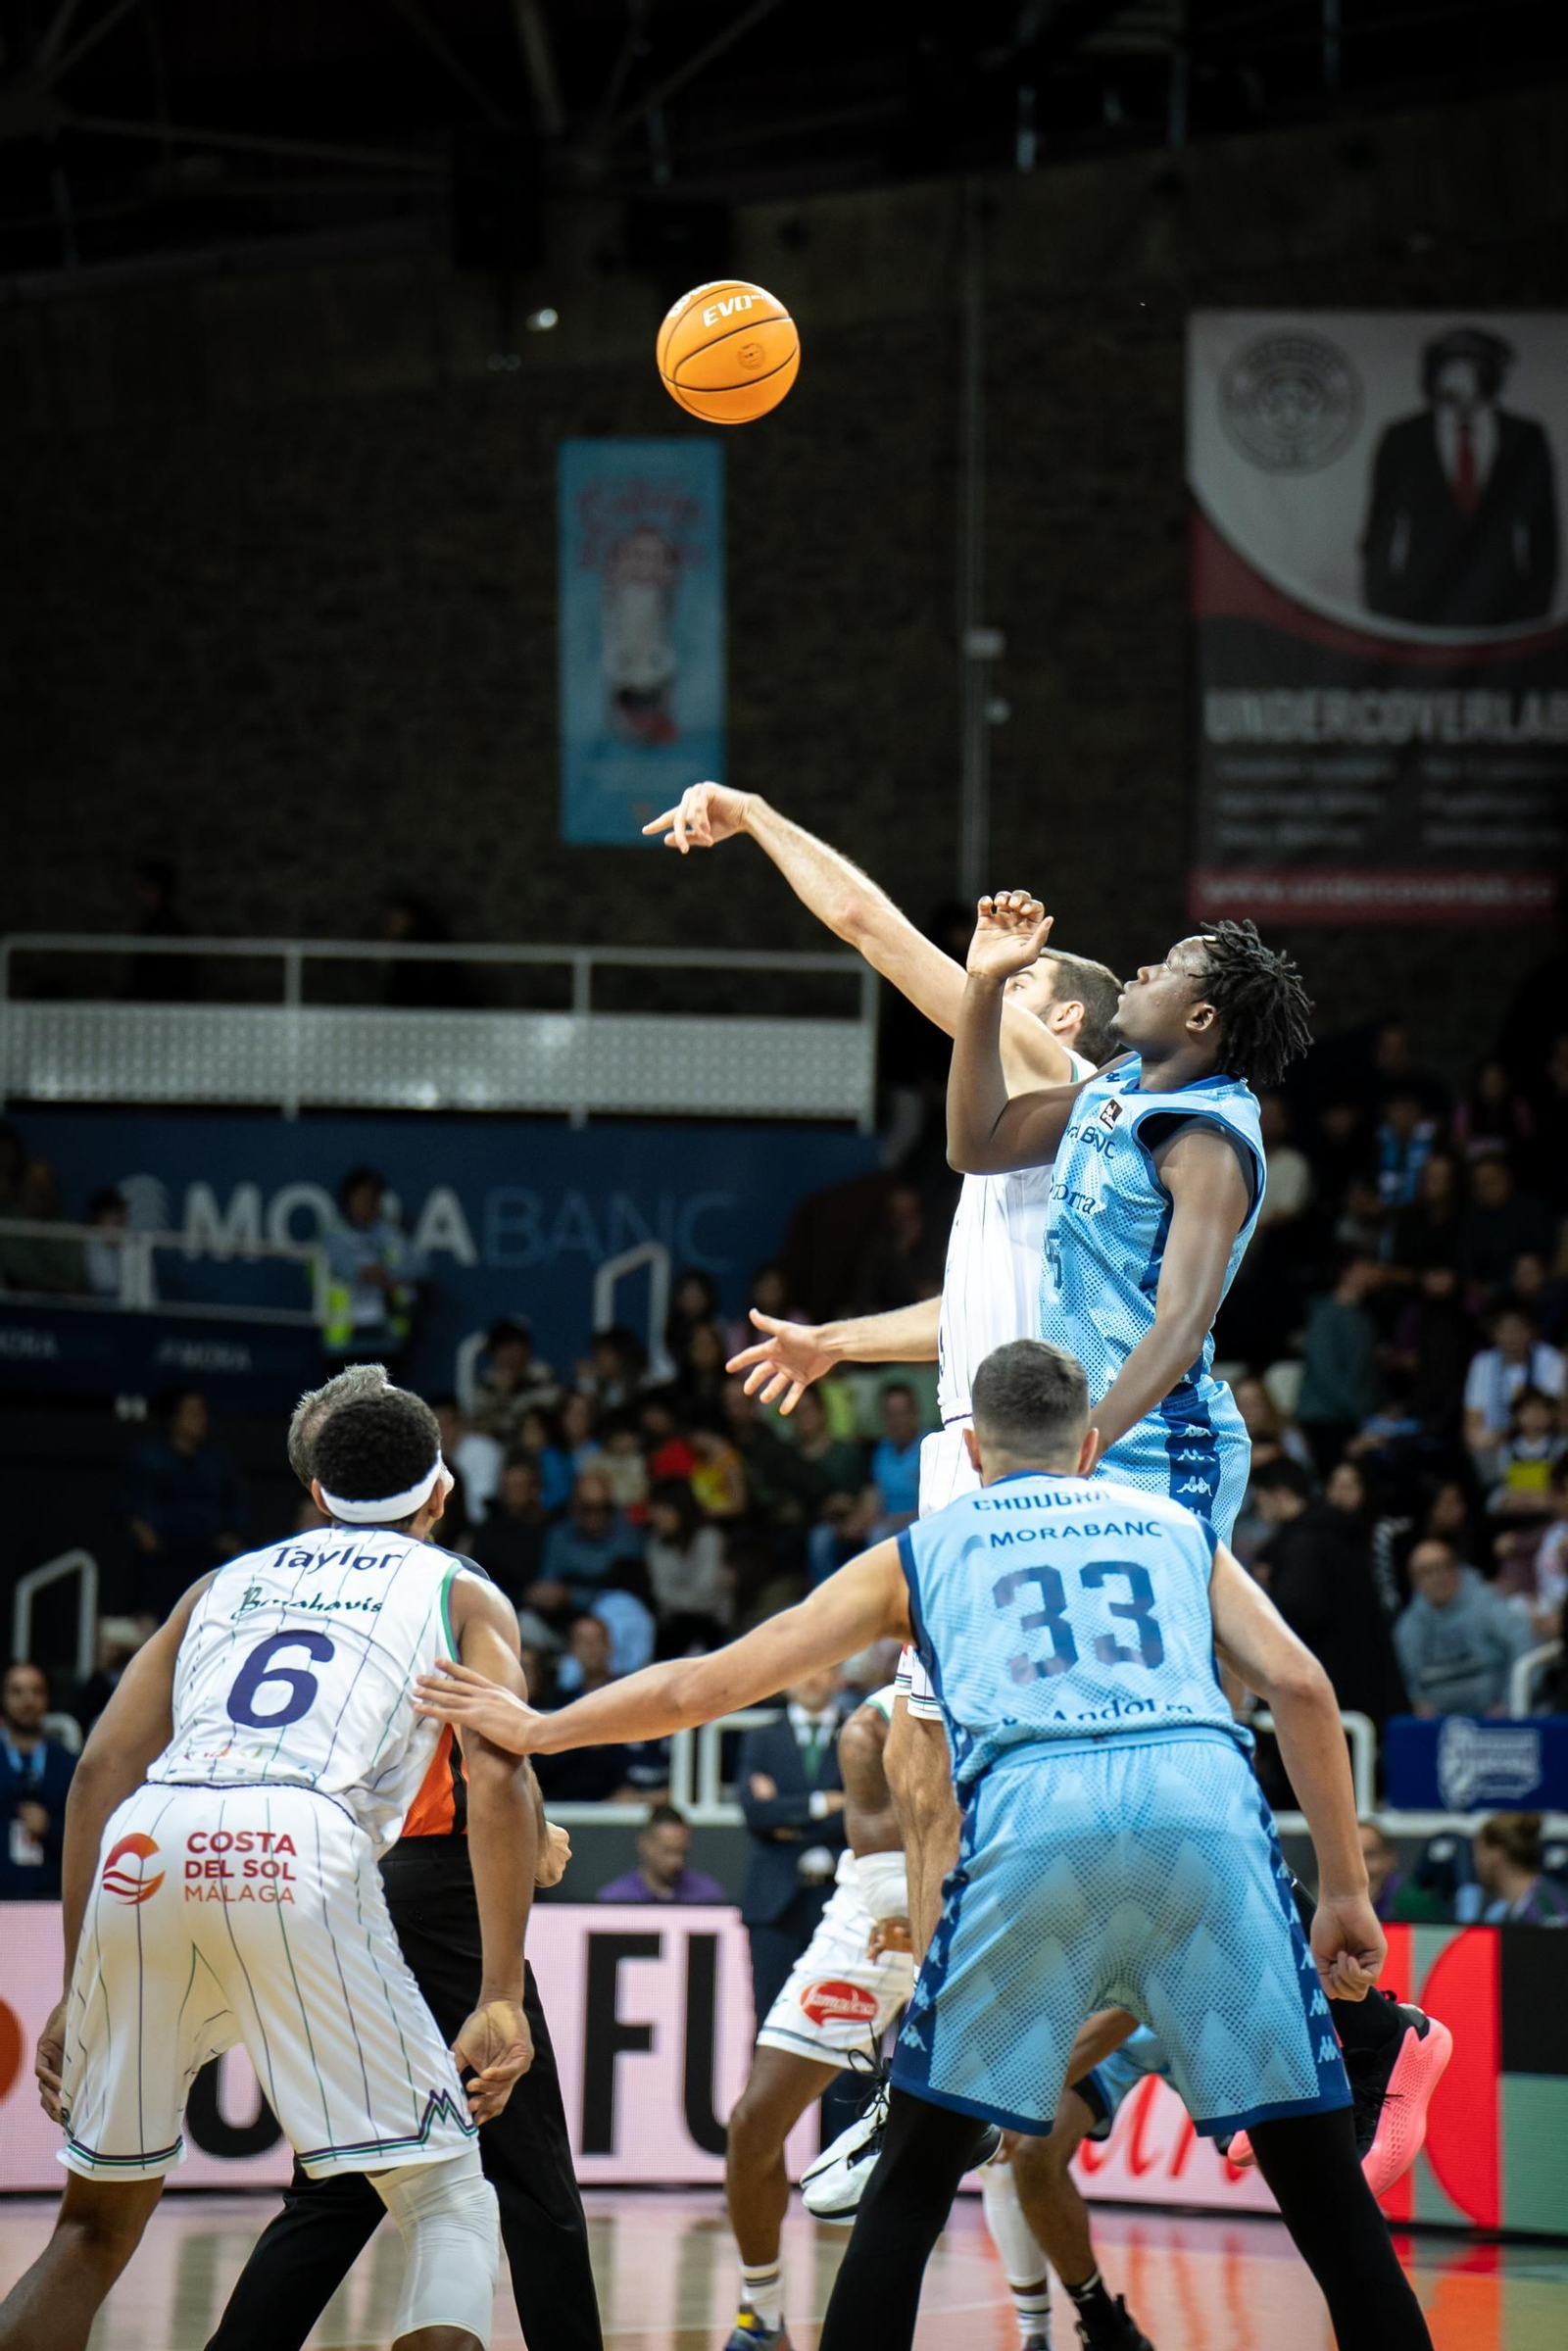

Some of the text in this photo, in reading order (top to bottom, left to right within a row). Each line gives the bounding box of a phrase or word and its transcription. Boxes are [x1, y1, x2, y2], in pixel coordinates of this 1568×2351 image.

[702, 295, 753, 328] EVO
[183, 1180, 737, 1274] MOABANC
[990, 1520, 1163, 1548] MORABANC
[272, 1545, 403, 1575] Taylor
[992, 1560, 1165, 1686] 33
[226, 1629, 335, 1729] 6
[187, 1831, 297, 1857] COSTA
[184, 1859, 297, 1881] DEL SOL
[184, 1880, 296, 1905] MÁLAGA
